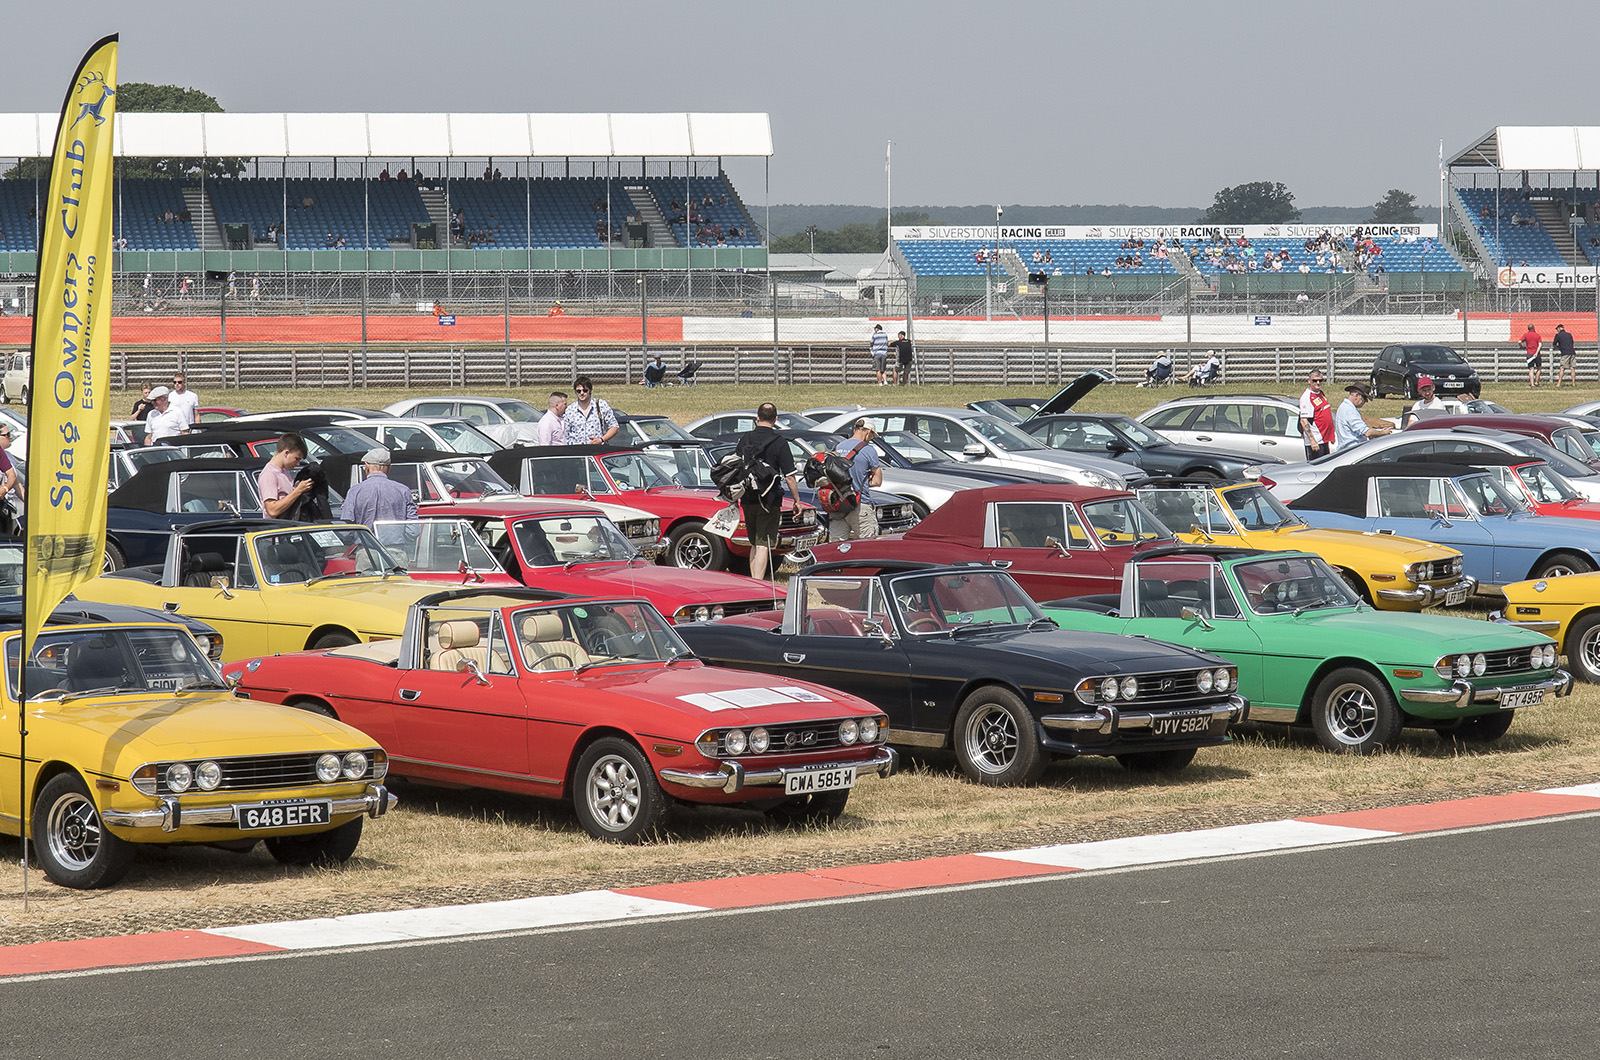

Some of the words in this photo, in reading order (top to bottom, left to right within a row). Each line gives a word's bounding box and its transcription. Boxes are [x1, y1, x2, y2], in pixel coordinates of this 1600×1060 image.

[61, 139, 85, 239] Club
[928, 227, 998, 239] SILVERSTONE
[1001, 227, 1042, 238] RACING
[1046, 228, 1065, 237] CLUB
[1108, 227, 1179, 238] SILVERSTONE
[1180, 227, 1221, 237] RACING
[1224, 227, 1244, 236] CLUB
[87, 255, 97, 296] 1979
[1520, 272, 1551, 284] A.C.
[1556, 272, 1600, 284] Enter
[82, 303, 93, 410] Established
[50, 422, 81, 511] Stag
[1501, 693, 1521, 707] LFY
[1521, 690, 1544, 705] 495R
[1154, 719, 1180, 735] JYV
[1181, 716, 1211, 733] 582K
[790, 774, 814, 792] CWA
[818, 771, 841, 788] 585
[844, 769, 852, 785] M
